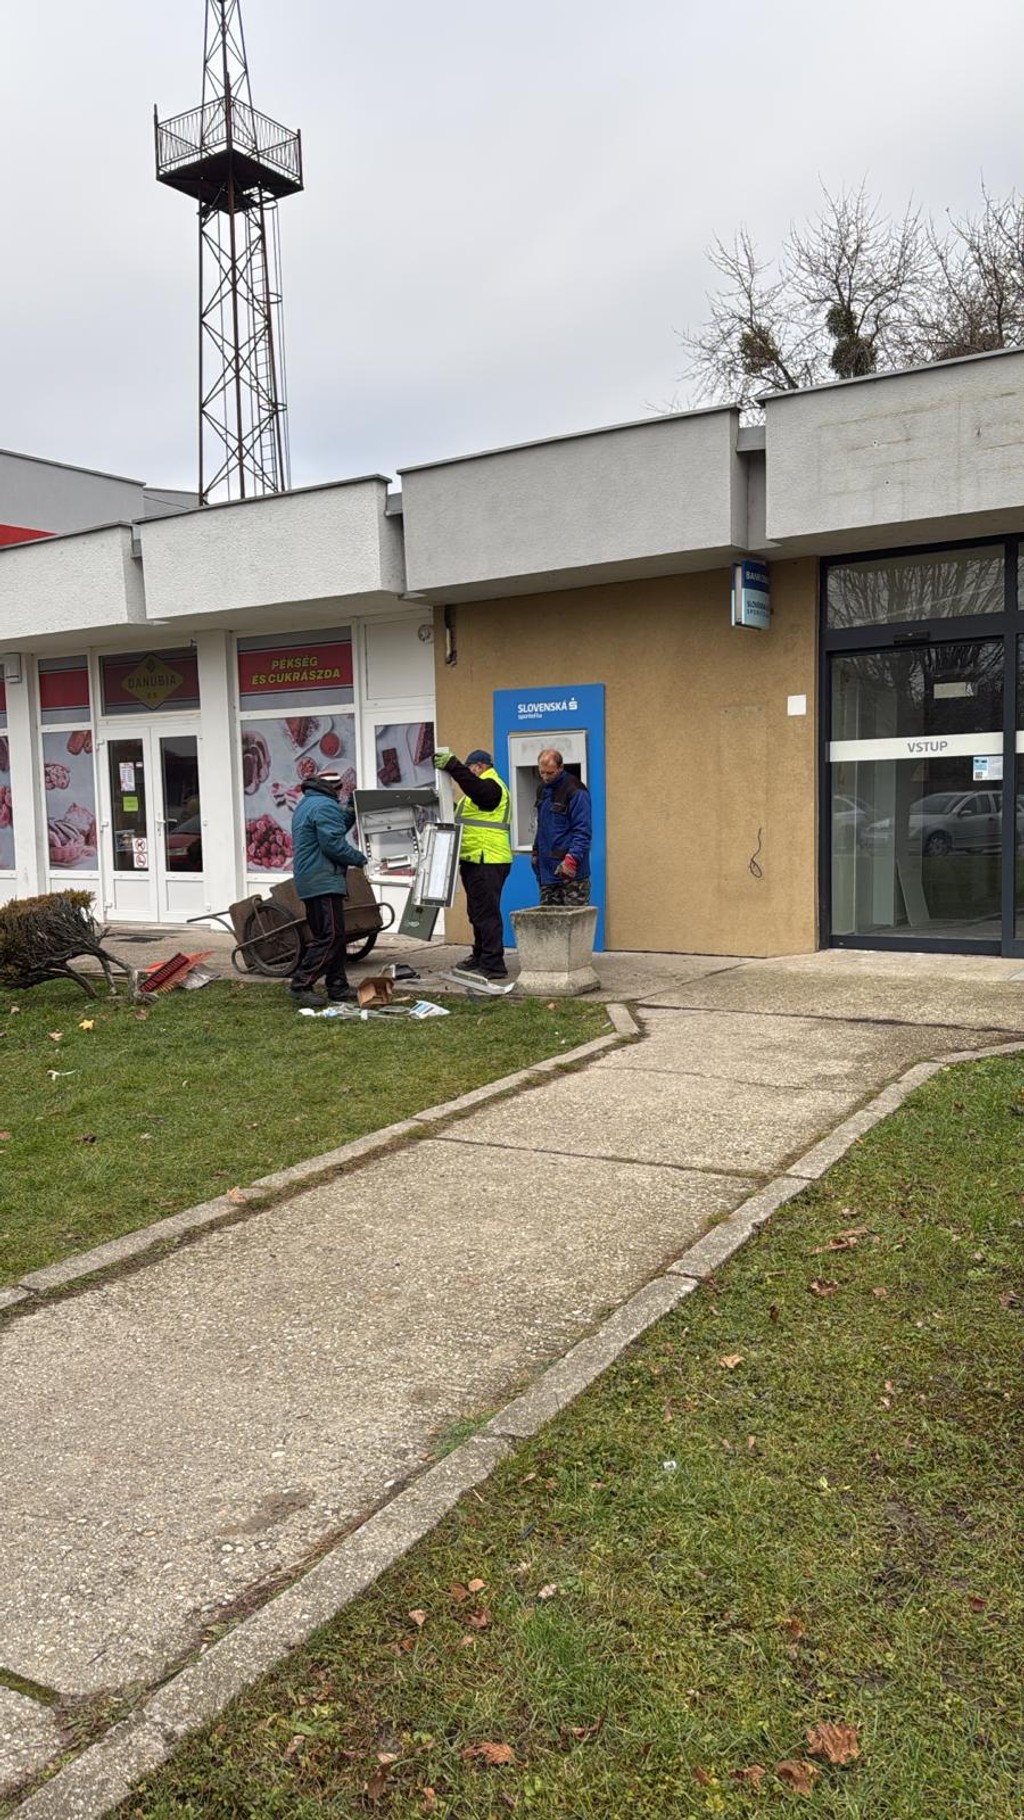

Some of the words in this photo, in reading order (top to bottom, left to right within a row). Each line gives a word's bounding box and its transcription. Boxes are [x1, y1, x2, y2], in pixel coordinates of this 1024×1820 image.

[271, 655, 318, 670] PÉKSÉG
[127, 674, 177, 689] DANUBIA
[252, 672, 266, 685] ÉS
[268, 668, 341, 684] CUKRÁSZDA
[517, 699, 568, 714] SLOVENSKÁ
[907, 740, 948, 753] VSTUP
